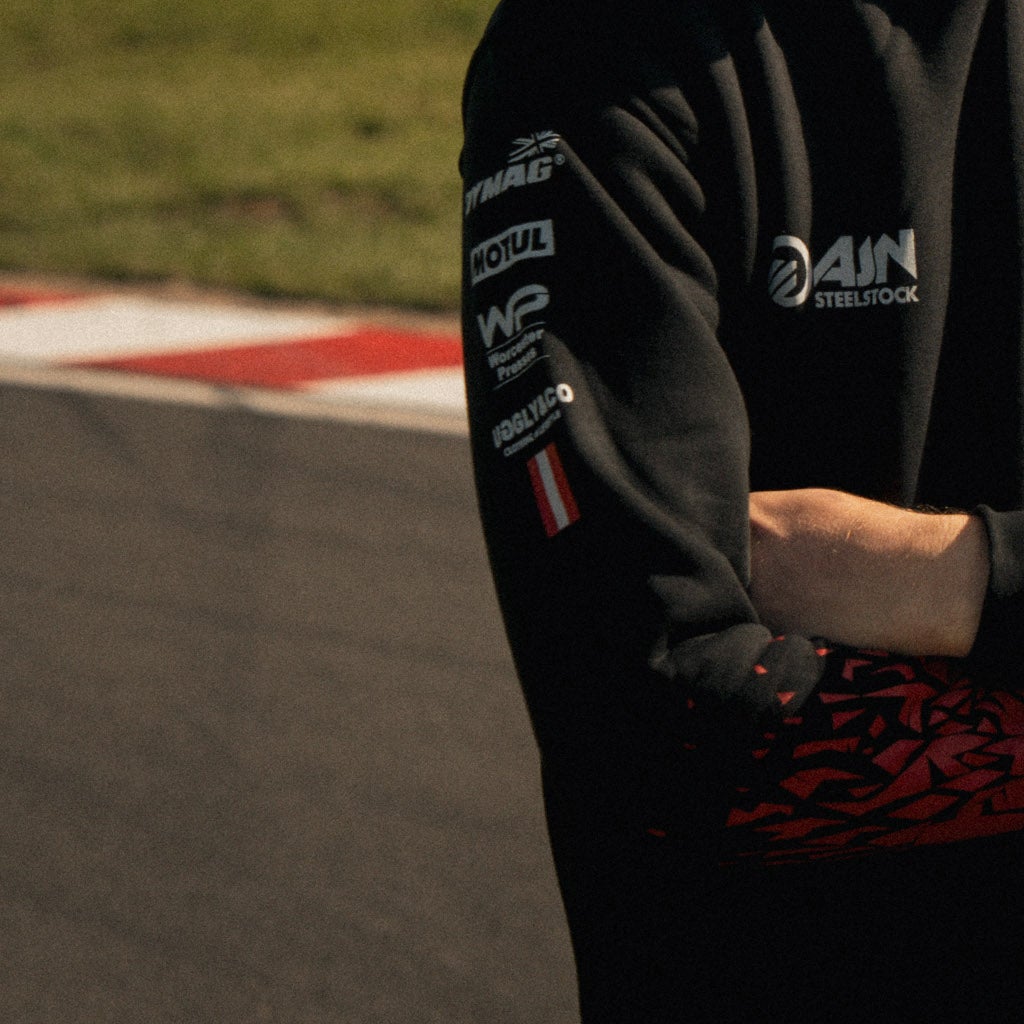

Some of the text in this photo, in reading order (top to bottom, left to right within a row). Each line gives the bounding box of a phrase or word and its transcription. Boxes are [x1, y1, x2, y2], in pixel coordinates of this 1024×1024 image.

[473, 227, 548, 277] MOTUL
[813, 228, 918, 288] AJN
[476, 283, 550, 349] WP
[815, 285, 920, 309] STEELSTOCK
